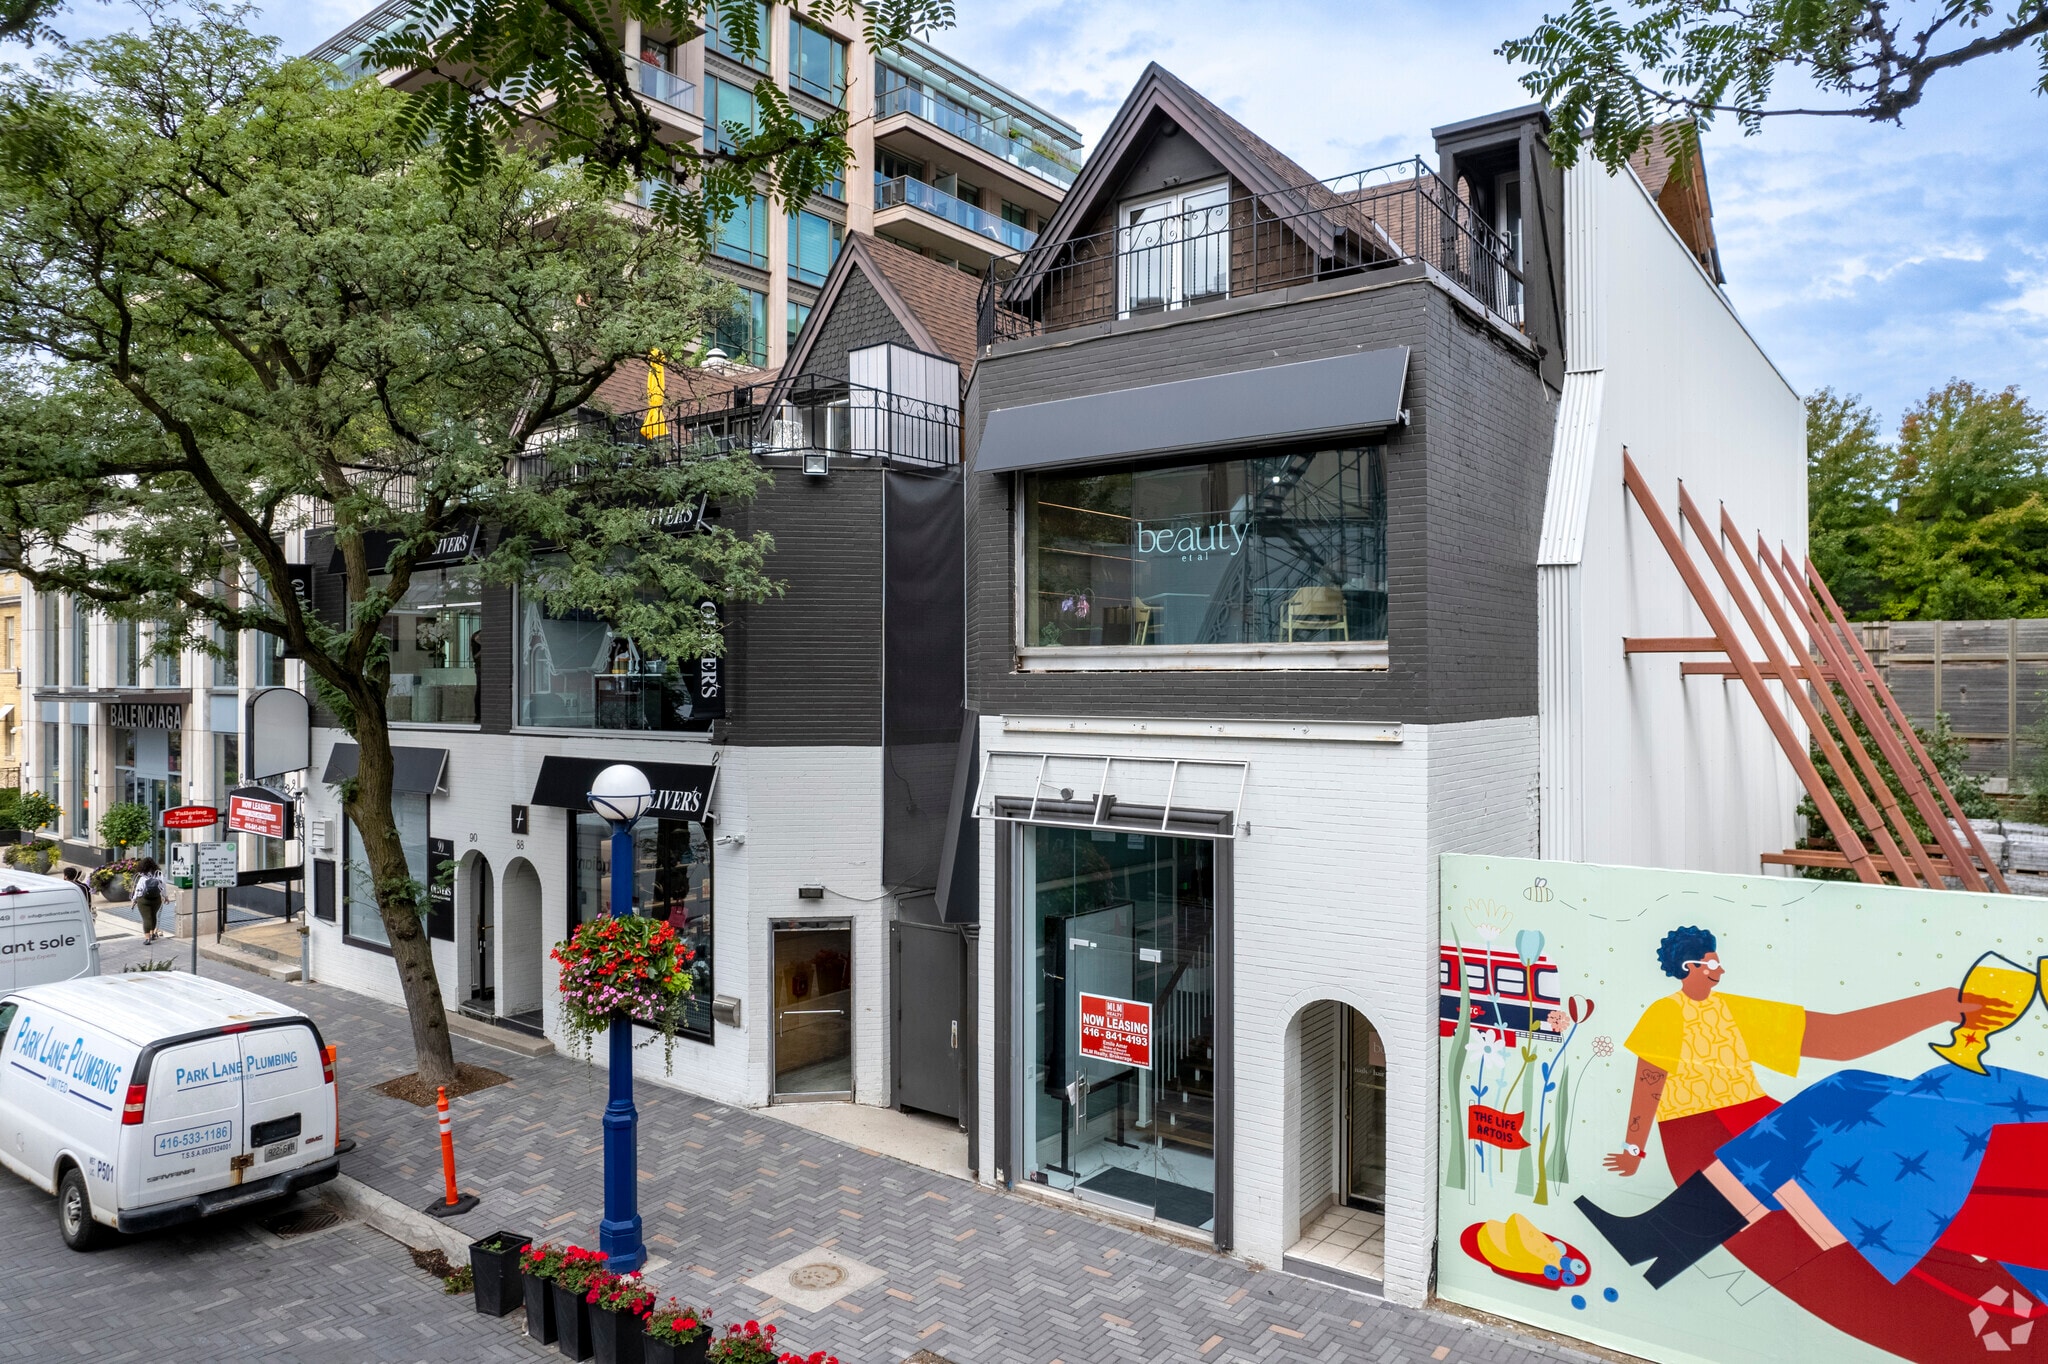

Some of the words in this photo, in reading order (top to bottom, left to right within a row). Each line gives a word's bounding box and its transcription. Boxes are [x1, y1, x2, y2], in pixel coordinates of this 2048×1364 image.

[1137, 520, 1250, 556] beauty
[1181, 554, 1192, 562] et
[1197, 551, 1209, 561] al
[110, 704, 182, 730] BALENCIAGA
[180, 817, 215, 825] Cleaning
[469, 833, 478, 842] 90
[516, 840, 525, 850] 88
[40, 934, 76, 950] sole
[1107, 1002, 1122, 1012] MLM
[1083, 1012, 1105, 1027] NOW
[1106, 1017, 1148, 1035] LEASING
[13, 1016, 44, 1060] PARK
[39, 1026, 70, 1071] LANE
[65, 1037, 122, 1095] PLUMBING
[176, 1067, 209, 1085] PARK
[212, 1061, 243, 1078] LANE
[246, 1051, 298, 1072] PLUMBING
[46, 1075, 68, 1094] LIMITED
[1473, 1111, 1493, 1124] THE
[1495, 1116, 1516, 1131] LIFE
[160, 1126, 228, 1150] 416-533-1186
[305, 1134, 324, 1145] GMC
[1477, 1124, 1513, 1143] ARTOIS
[97, 1160, 114, 1184] P501
